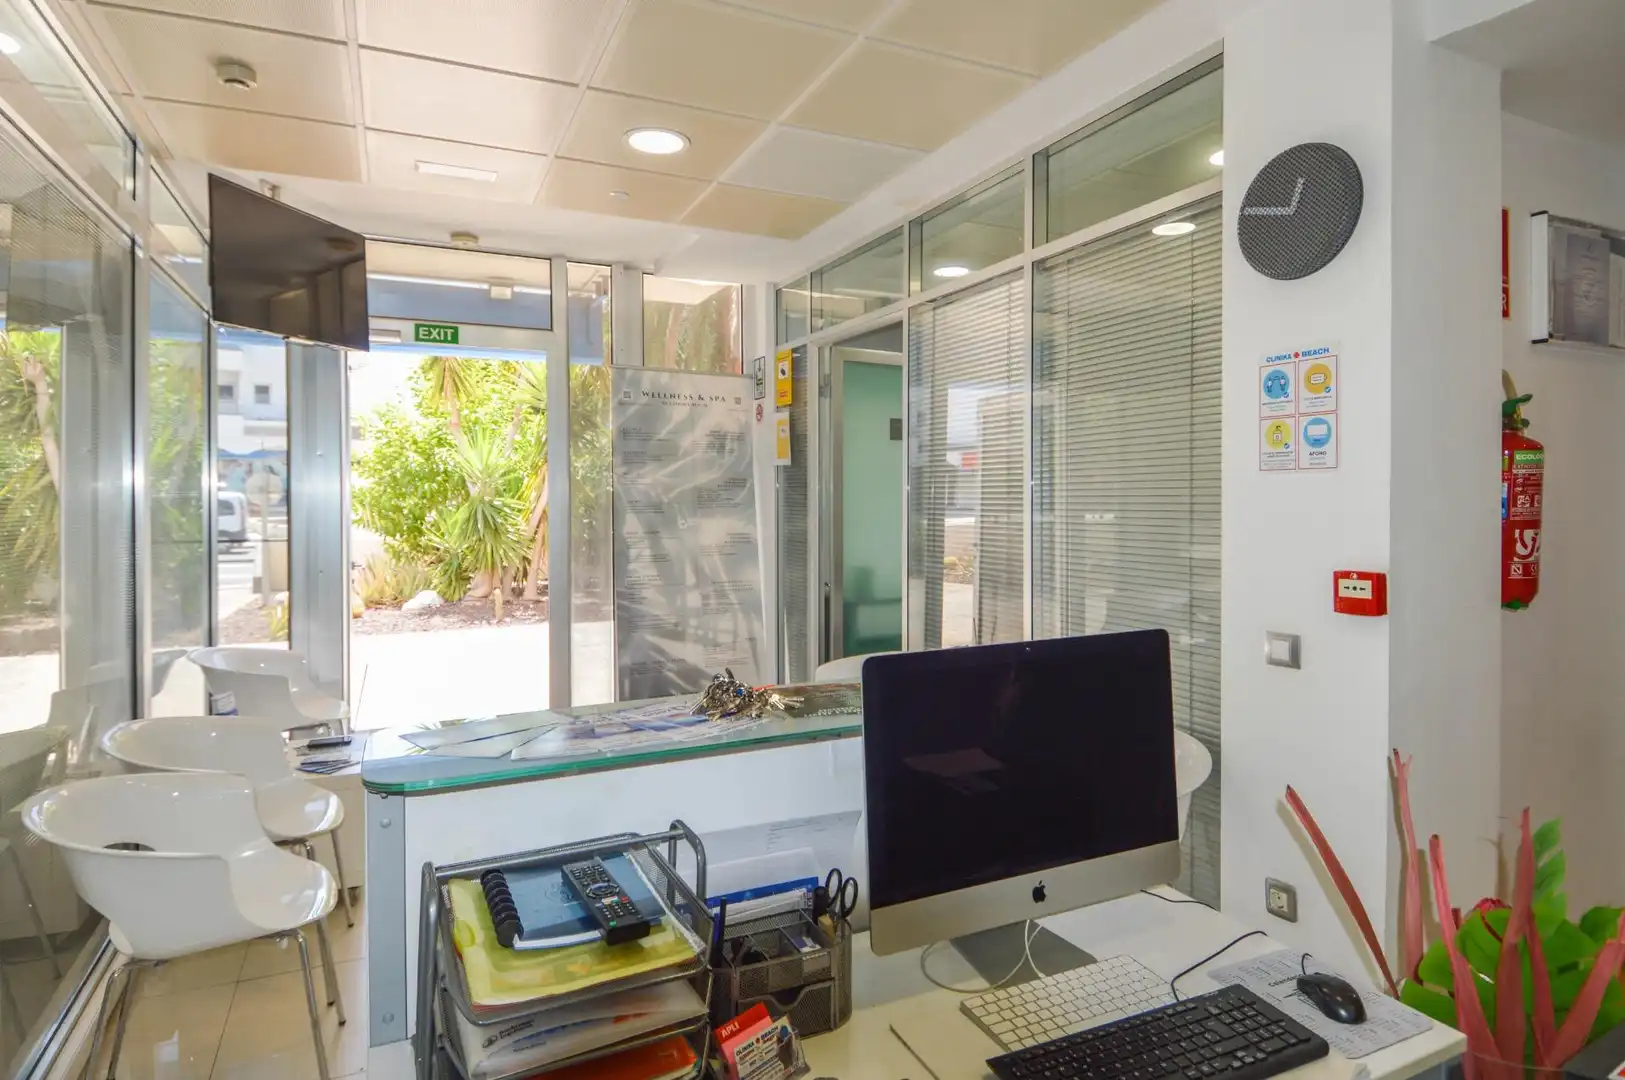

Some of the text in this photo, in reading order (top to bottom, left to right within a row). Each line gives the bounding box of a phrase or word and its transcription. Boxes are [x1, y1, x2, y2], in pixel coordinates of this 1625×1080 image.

[419, 327, 455, 341] EXIT
[1266, 347, 1330, 363] CLINIKA BEACH
[641, 390, 694, 401] WELLNESS
[720, 1022, 740, 1038] APLI
